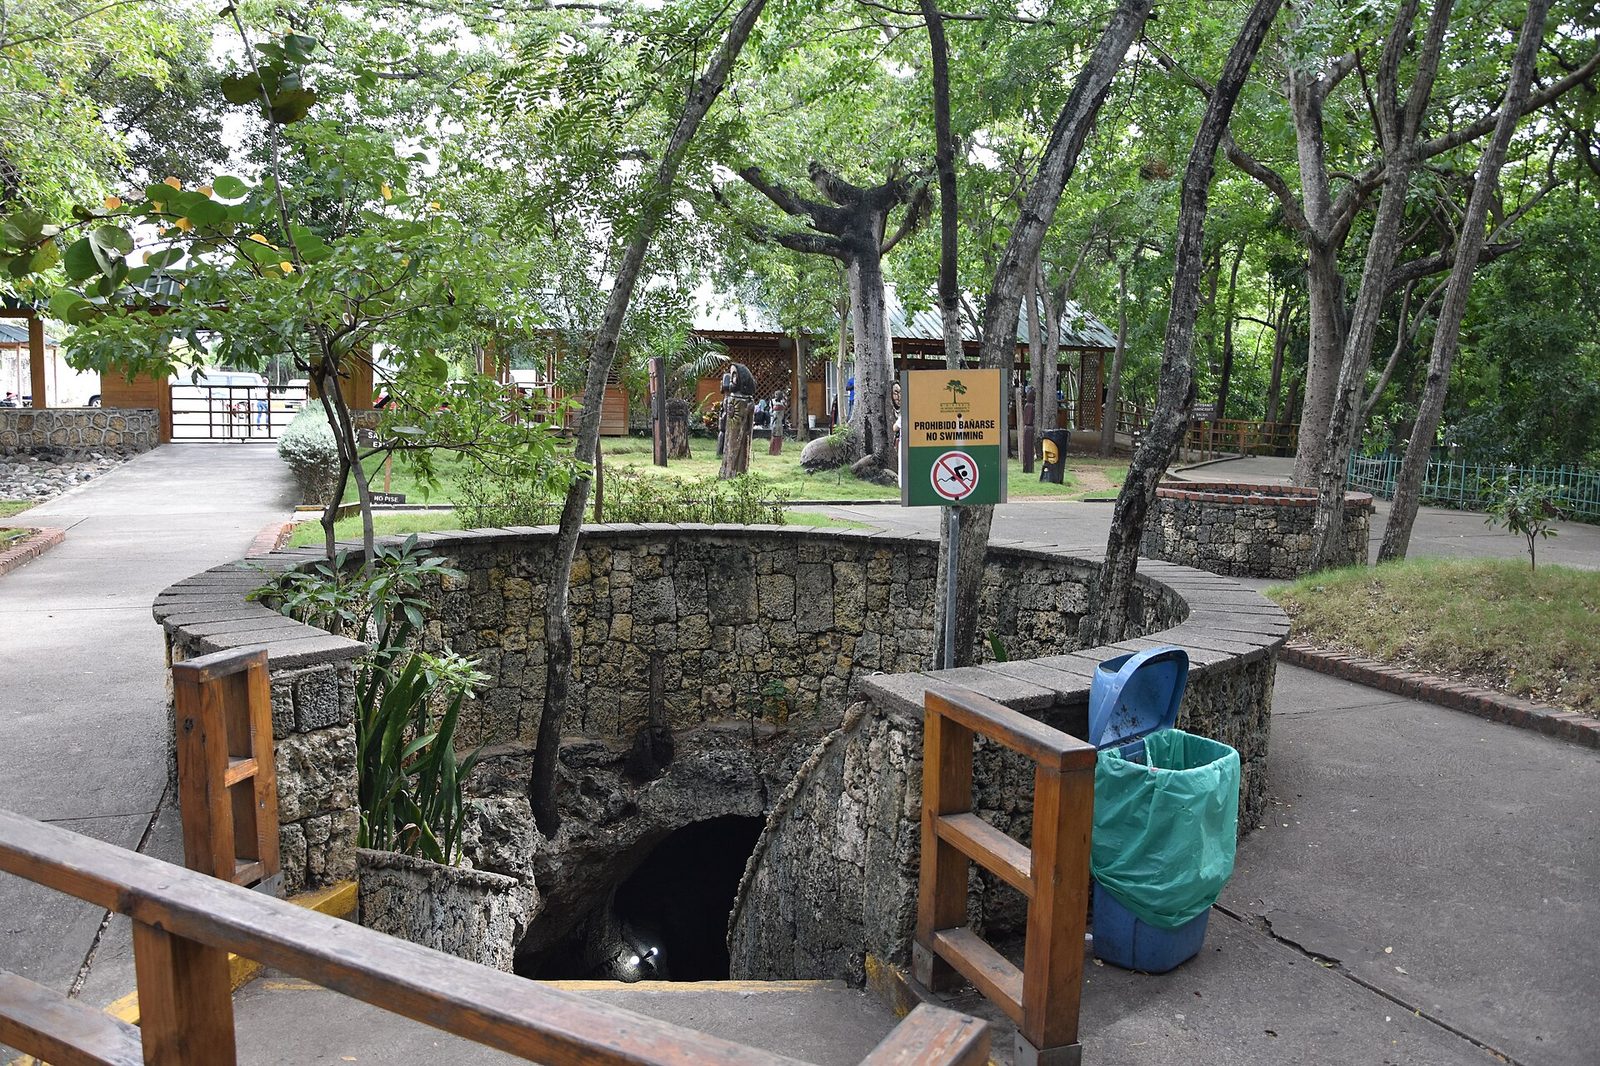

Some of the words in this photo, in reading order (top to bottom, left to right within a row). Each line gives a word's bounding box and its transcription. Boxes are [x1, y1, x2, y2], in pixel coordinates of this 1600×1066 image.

[914, 421, 956, 430] PROHIBIDO
[959, 419, 995, 430] BAÑARSE
[926, 432, 938, 441] NO
[940, 431, 984, 441] SWIMMING
